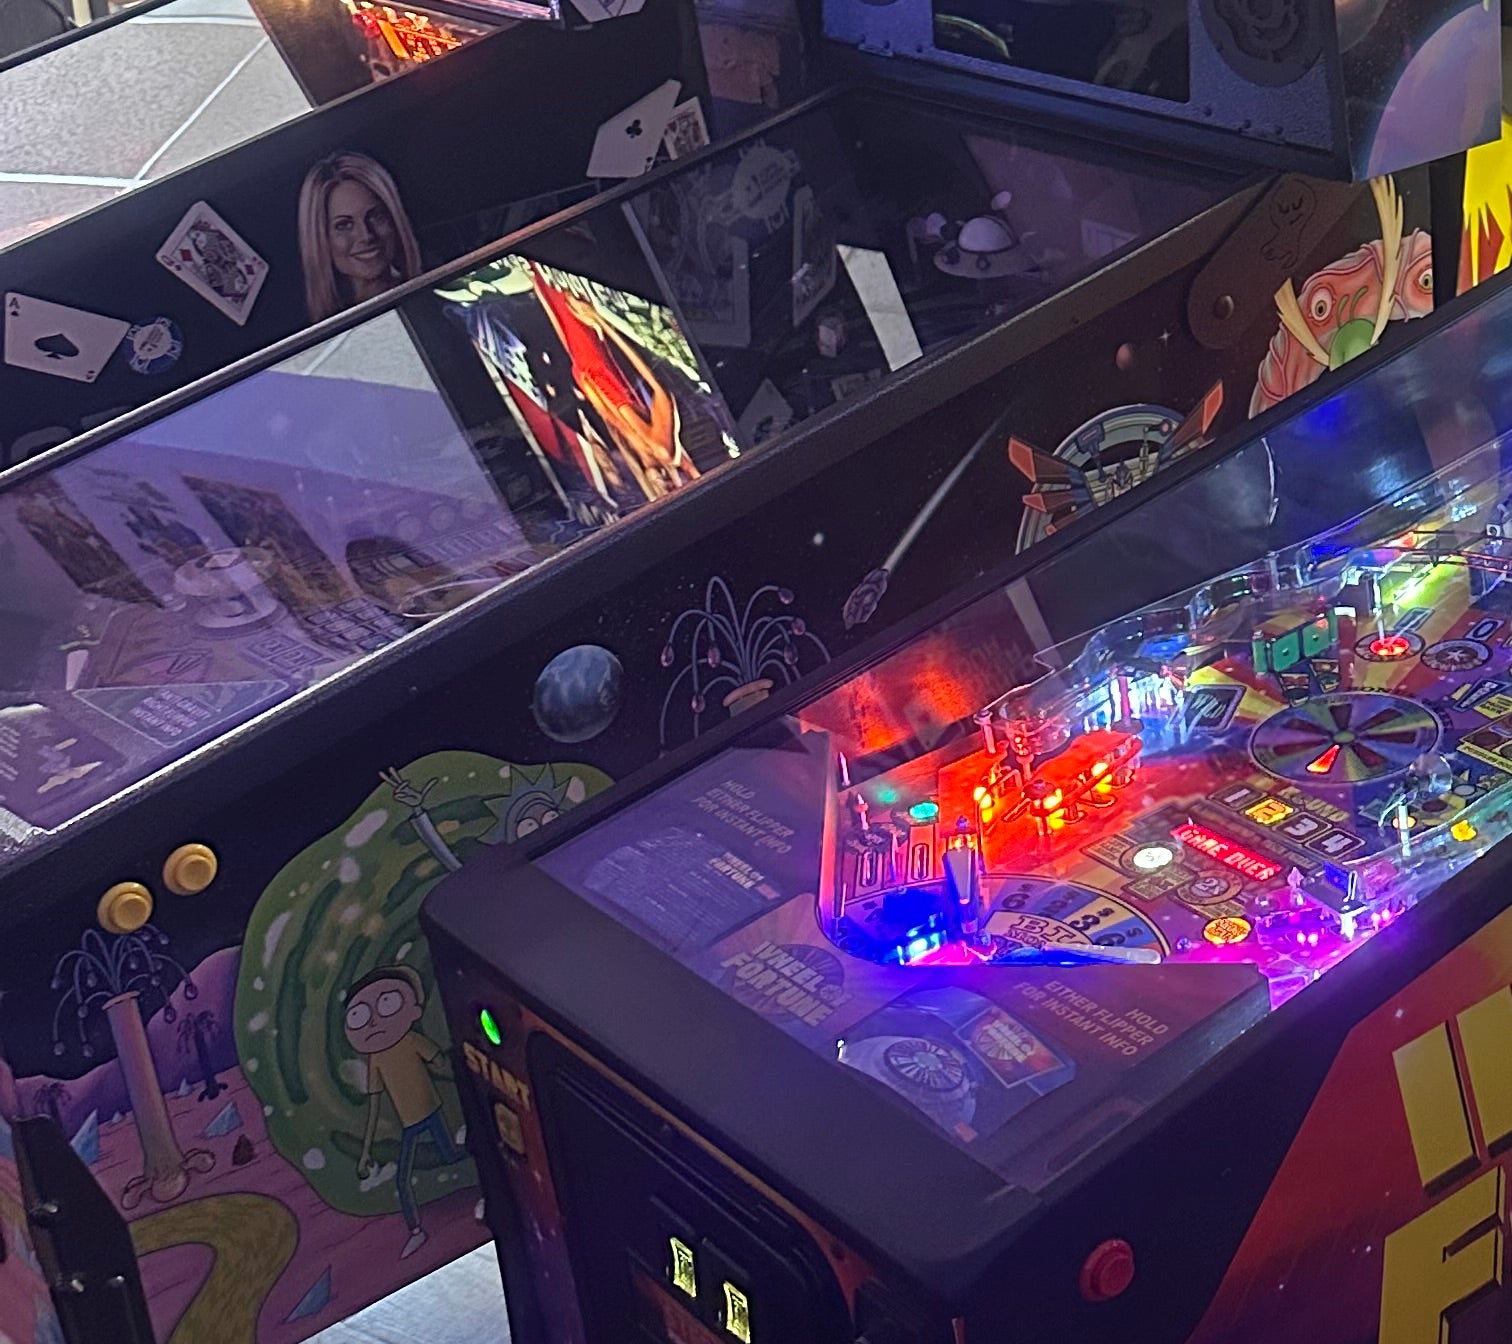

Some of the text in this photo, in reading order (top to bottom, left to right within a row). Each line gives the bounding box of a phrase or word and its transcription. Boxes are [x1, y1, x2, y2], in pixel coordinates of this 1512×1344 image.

[706, 787, 795, 838] EITHER FLIPPER
[720, 779, 756, 800] HOLD
[691, 796, 792, 855] FOR INSTANT INFO
[1251, 802, 1289, 822] 2
[1284, 816, 1319, 836] 3
[1321, 835, 1353, 854] 4
[1180, 827, 1221, 858] GAME
[1224, 850, 1275, 880] OVER
[722, 955, 835, 1028] FORTUNE
[753, 941, 821, 994] WHEEL
[1013, 982, 1139, 1057] FOR INSTANT INFO
[1045, 980, 1155, 1047] EITHER FLIPPER
[1125, 1008, 1169, 1036] HOLD
